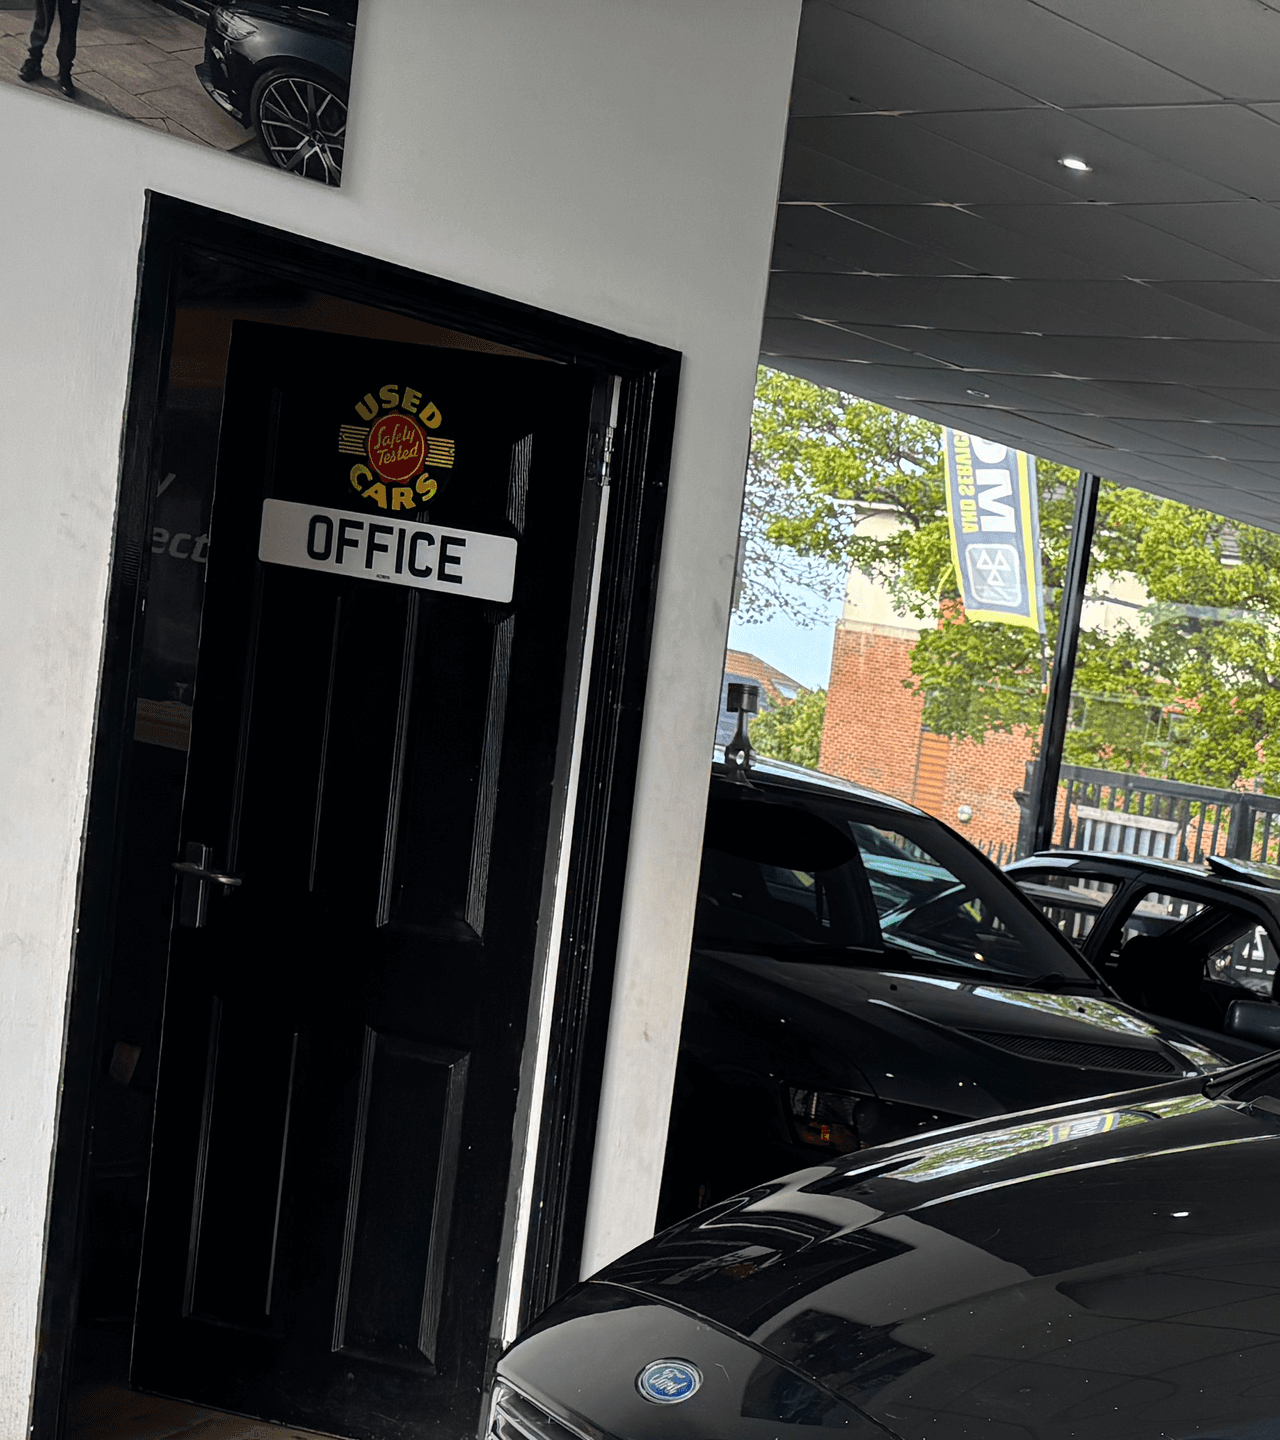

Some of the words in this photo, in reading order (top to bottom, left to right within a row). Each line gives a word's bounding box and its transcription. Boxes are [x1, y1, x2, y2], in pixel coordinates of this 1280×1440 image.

[355, 384, 442, 429] USED
[374, 424, 415, 450] Safely
[377, 441, 419, 465] Tested
[350, 463, 437, 510] CARS
[307, 514, 466, 584] OFFICE
